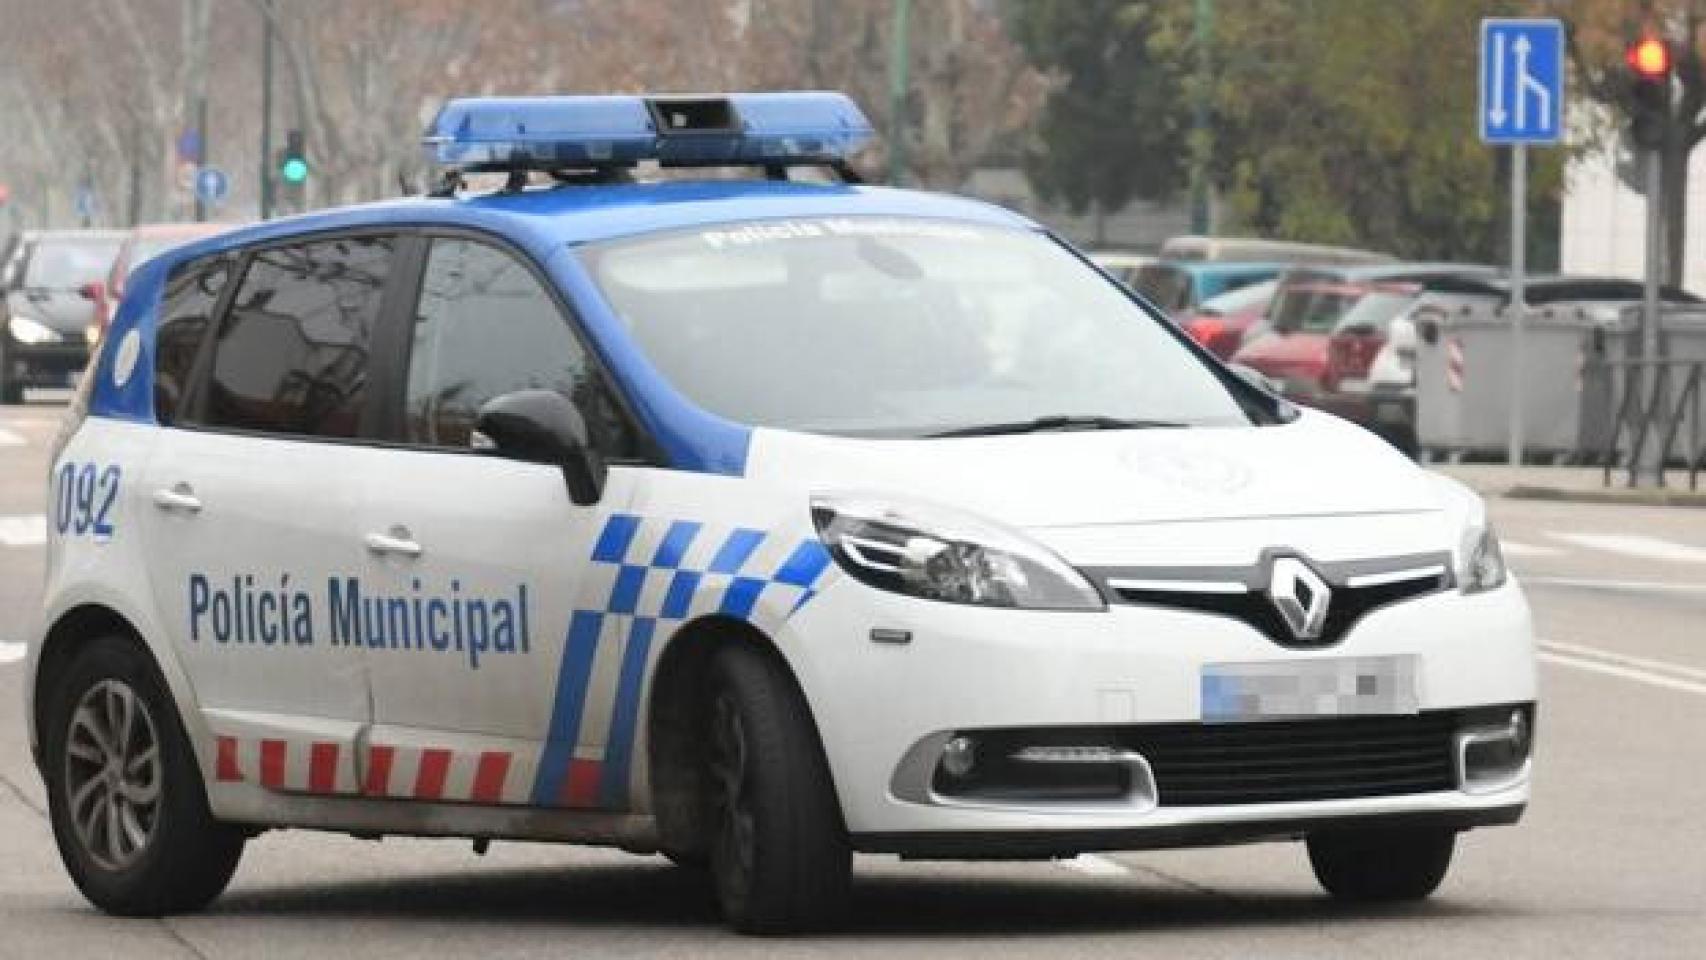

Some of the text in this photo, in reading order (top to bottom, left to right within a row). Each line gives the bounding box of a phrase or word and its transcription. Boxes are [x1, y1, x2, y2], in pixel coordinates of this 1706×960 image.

[56, 462, 121, 537] 092
[190, 573, 531, 669] Policía Municipal
